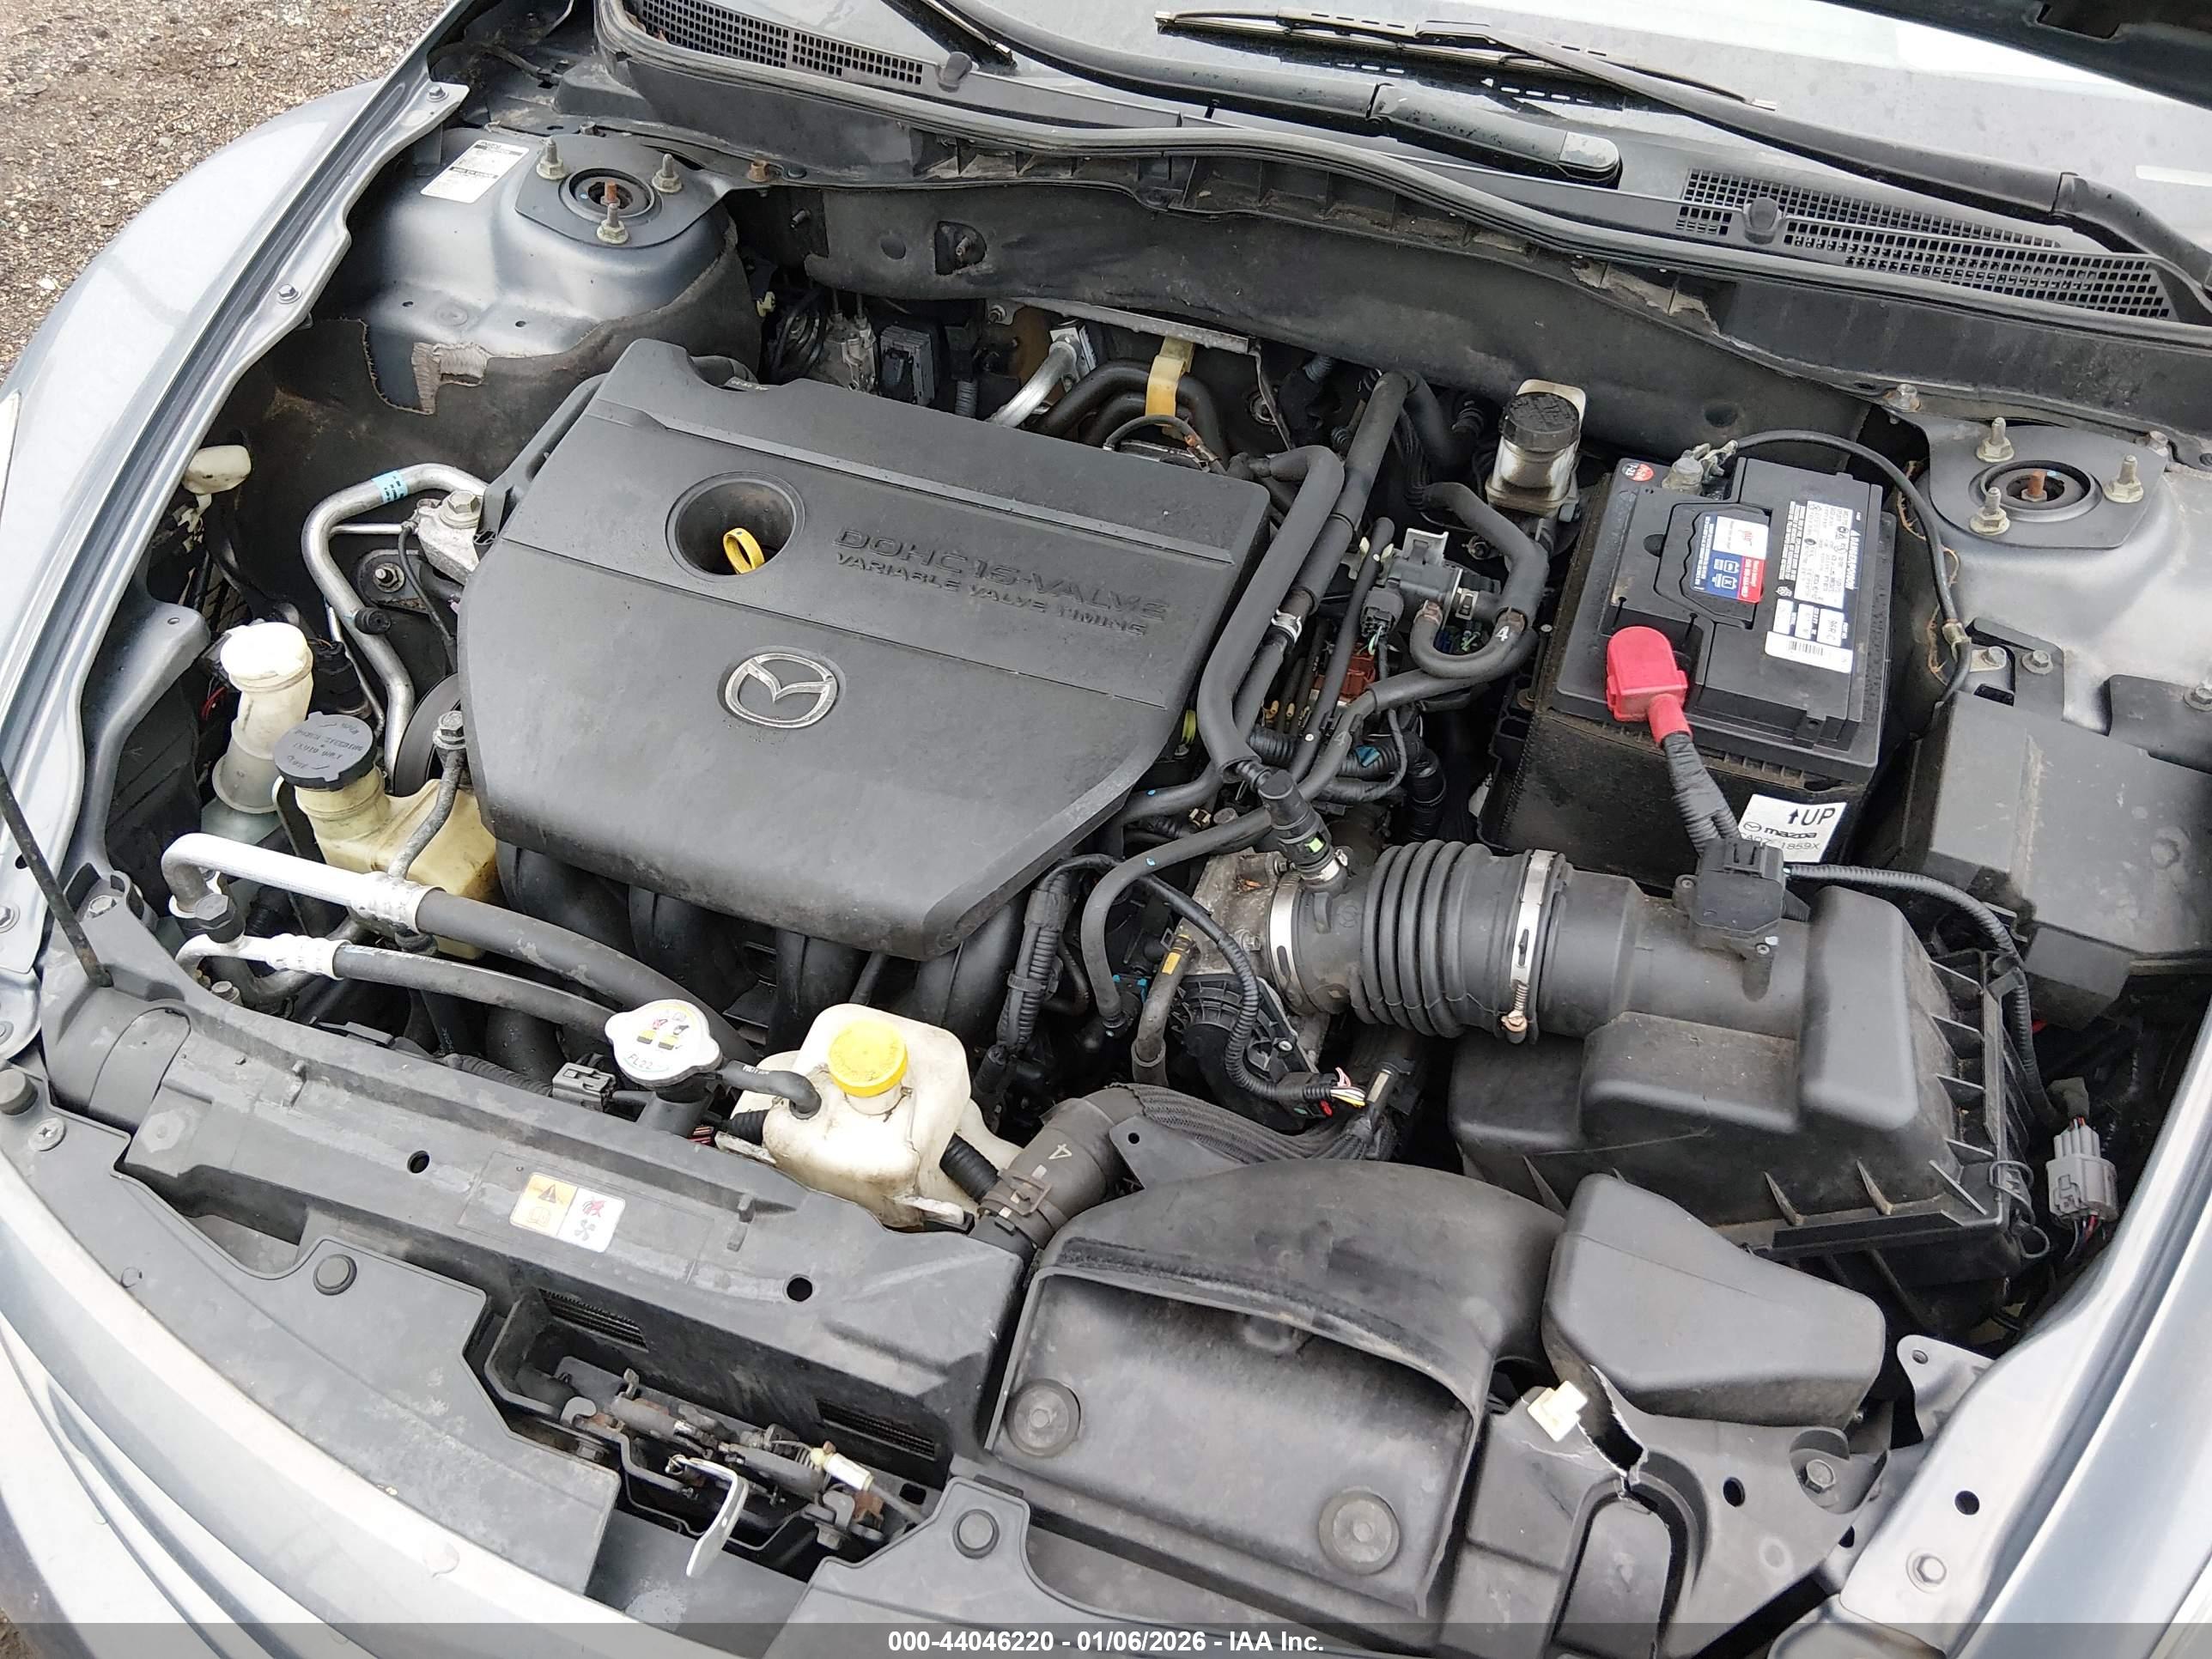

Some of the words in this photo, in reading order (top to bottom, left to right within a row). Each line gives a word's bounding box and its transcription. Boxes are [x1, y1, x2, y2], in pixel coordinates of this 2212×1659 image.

[831, 530, 968, 574] DOHC
[837, 552, 962, 592] VARIABLE
[969, 584, 1047, 614] VALVE
[1057, 604, 1148, 636] TIMING
[1495, 625, 1510, 641] 4
[1334, 731, 1347, 746] 4
[1801, 807, 1836, 826] UP
[1763, 827, 1817, 839] mazda
[627, 1053, 654, 1070] FL22
